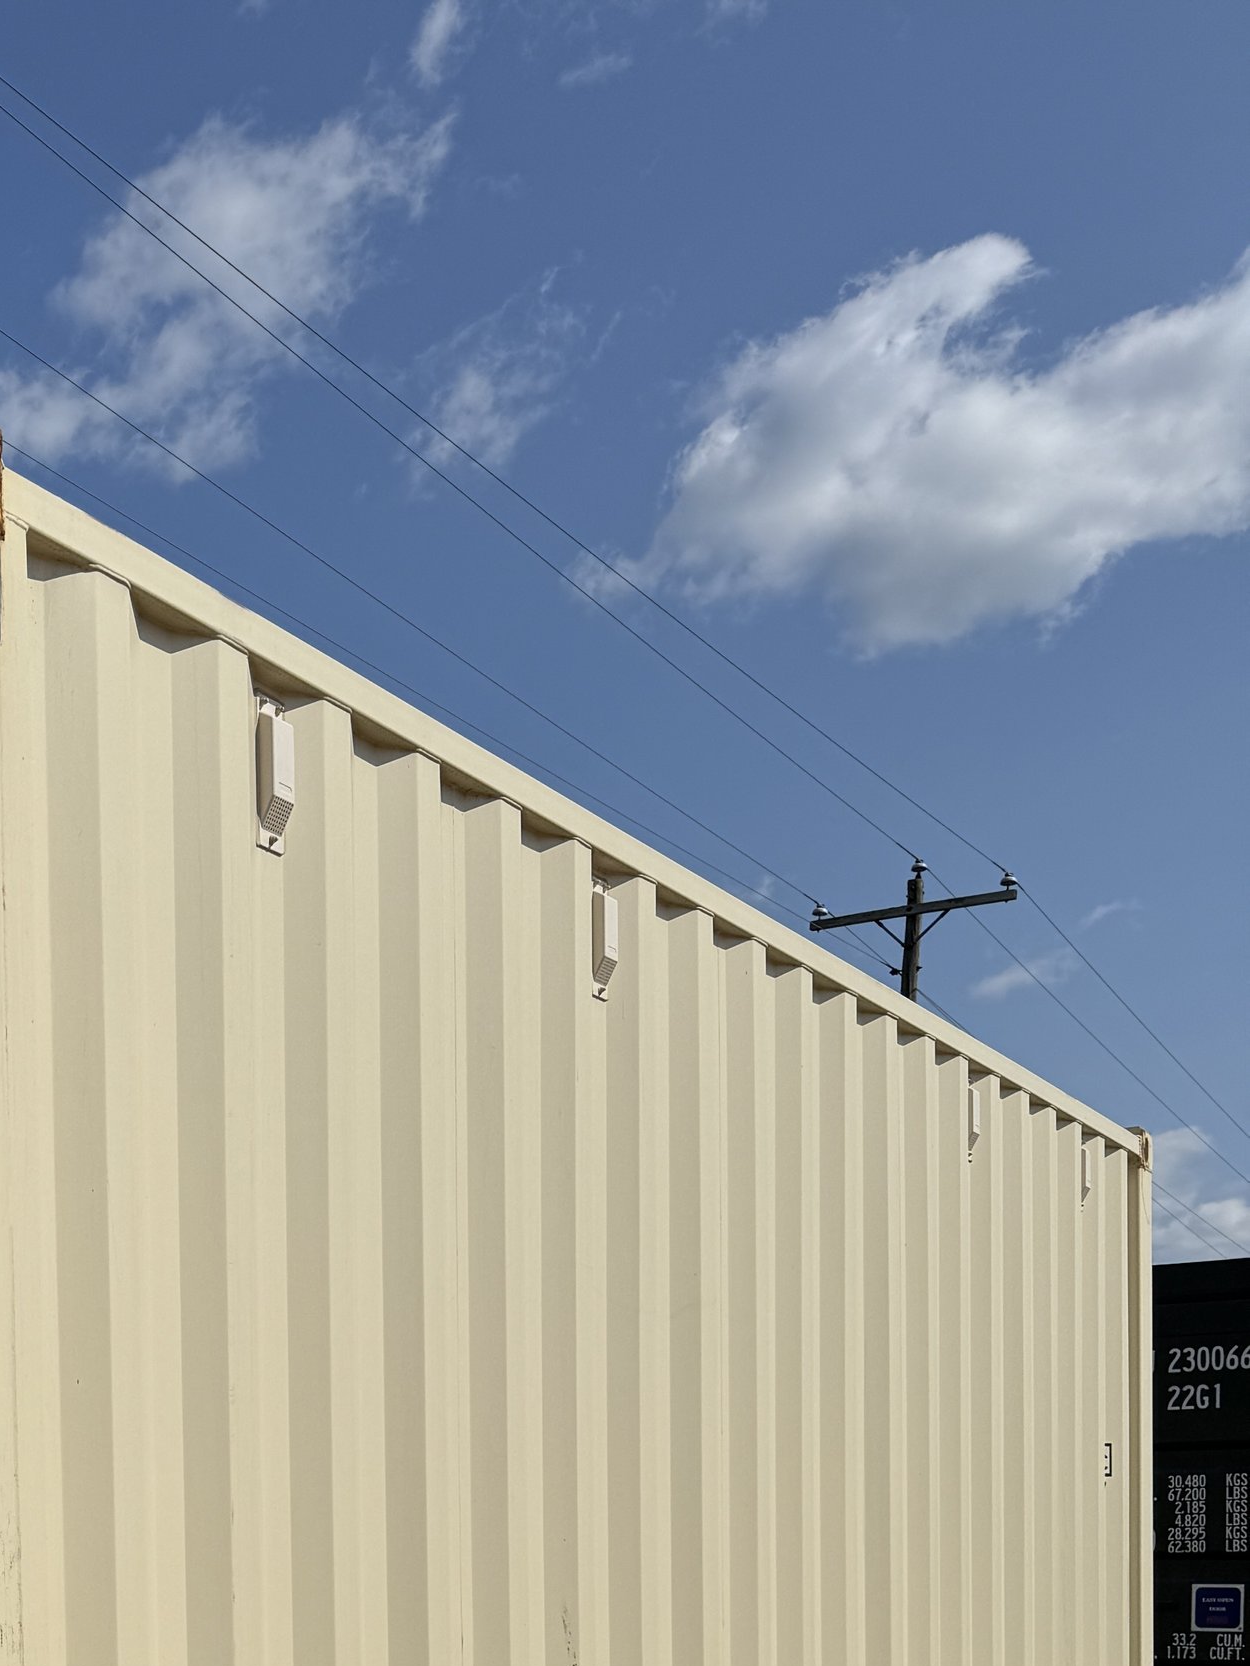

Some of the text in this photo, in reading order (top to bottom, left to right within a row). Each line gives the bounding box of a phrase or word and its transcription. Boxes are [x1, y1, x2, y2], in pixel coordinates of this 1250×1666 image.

[1167, 1383, 1221, 1411] 22G1
[1225, 1473, 1248, 1487] KGS
[1225, 1486, 1248, 1500] LBS
[1225, 1499, 1248, 1513] KGS
[1225, 1513, 1248, 1526] LBS
[1225, 1526, 1248, 1540] KGS
[1225, 1539, 1248, 1553] LBS
[1172, 1633, 1197, 1646] 33.2
